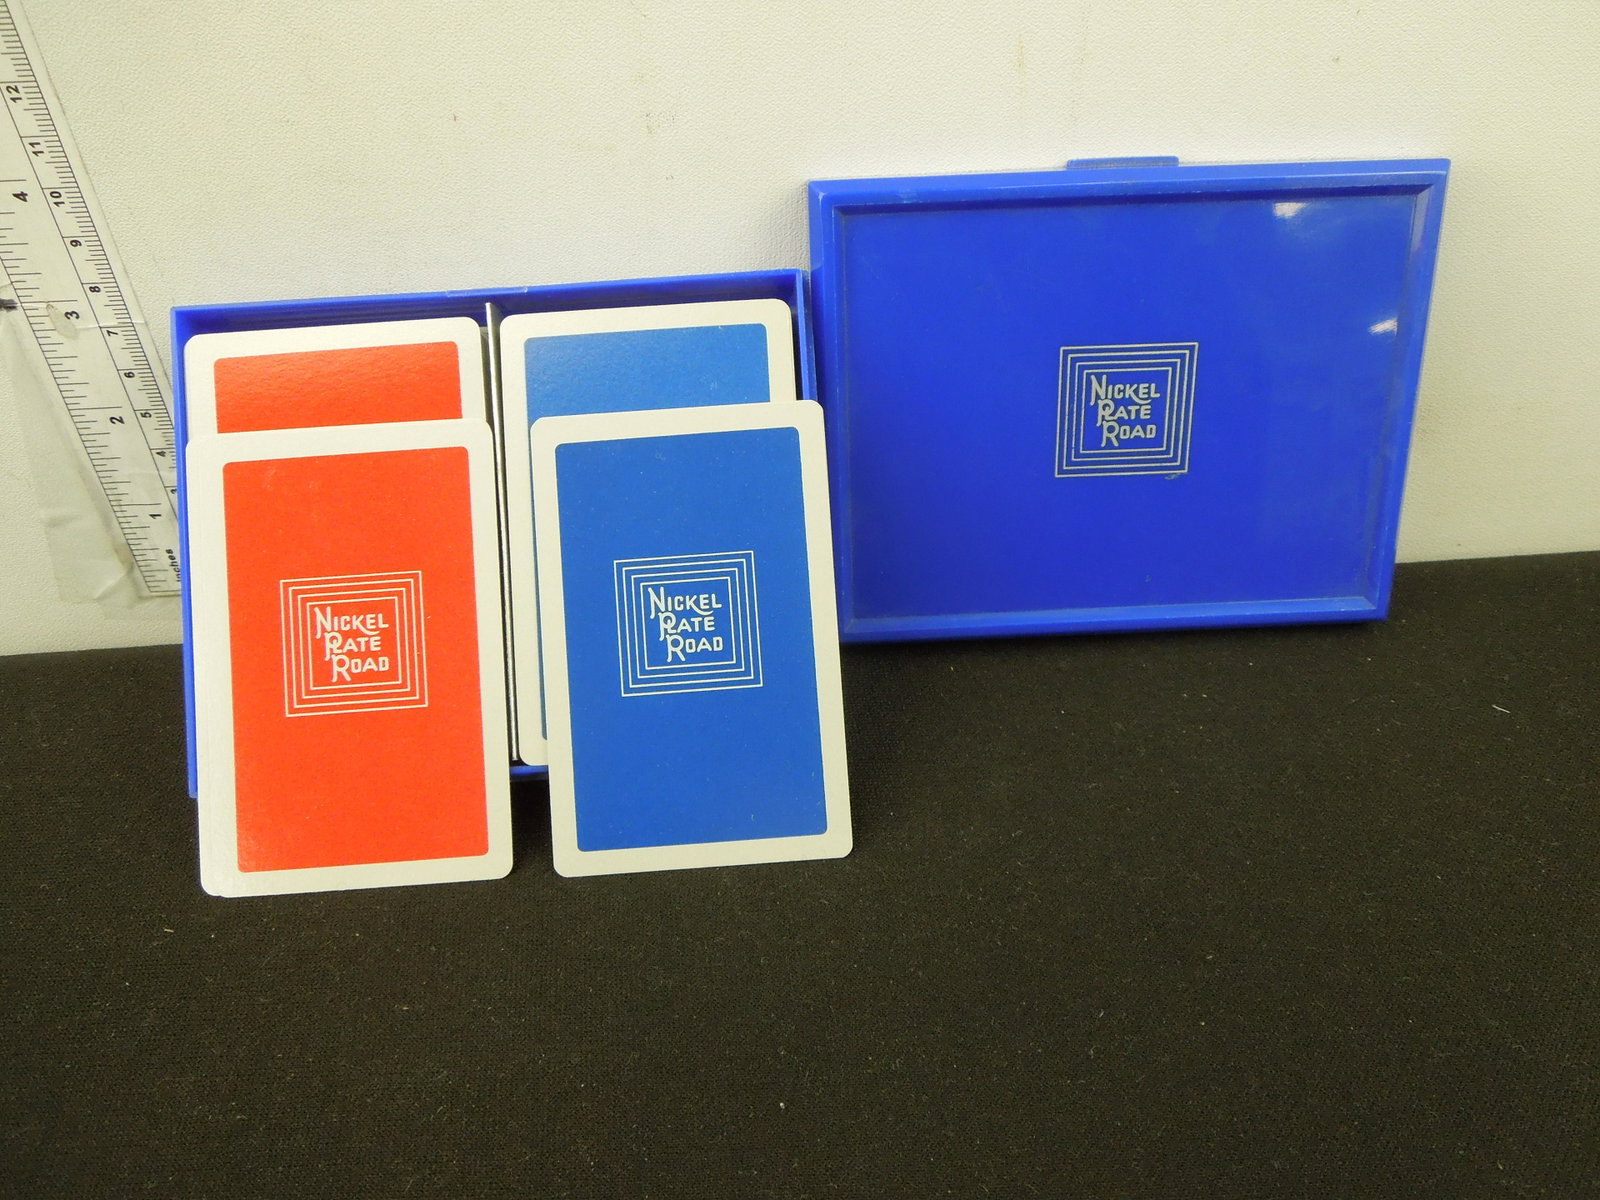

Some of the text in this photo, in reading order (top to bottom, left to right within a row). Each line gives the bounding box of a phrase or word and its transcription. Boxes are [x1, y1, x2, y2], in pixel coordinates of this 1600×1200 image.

[6, 85, 22, 103] 12
[29, 142, 44, 157] 11
[49, 191, 65, 207] 10
[70, 240, 83, 248] 9
[89, 285, 101, 294] 8
[107, 329, 119, 337] 7
[124, 371, 135, 379] 6
[12, 191, 162, 520] 4 3 2 1
[1089, 375, 1160, 406] NICKEL
[1101, 421, 1157, 447] ROAD
[648, 586, 722, 619] NICKEL
[314, 606, 389, 639] NICKEL
[666, 634, 723, 662] ROAD
[331, 654, 389, 682] ROAD
